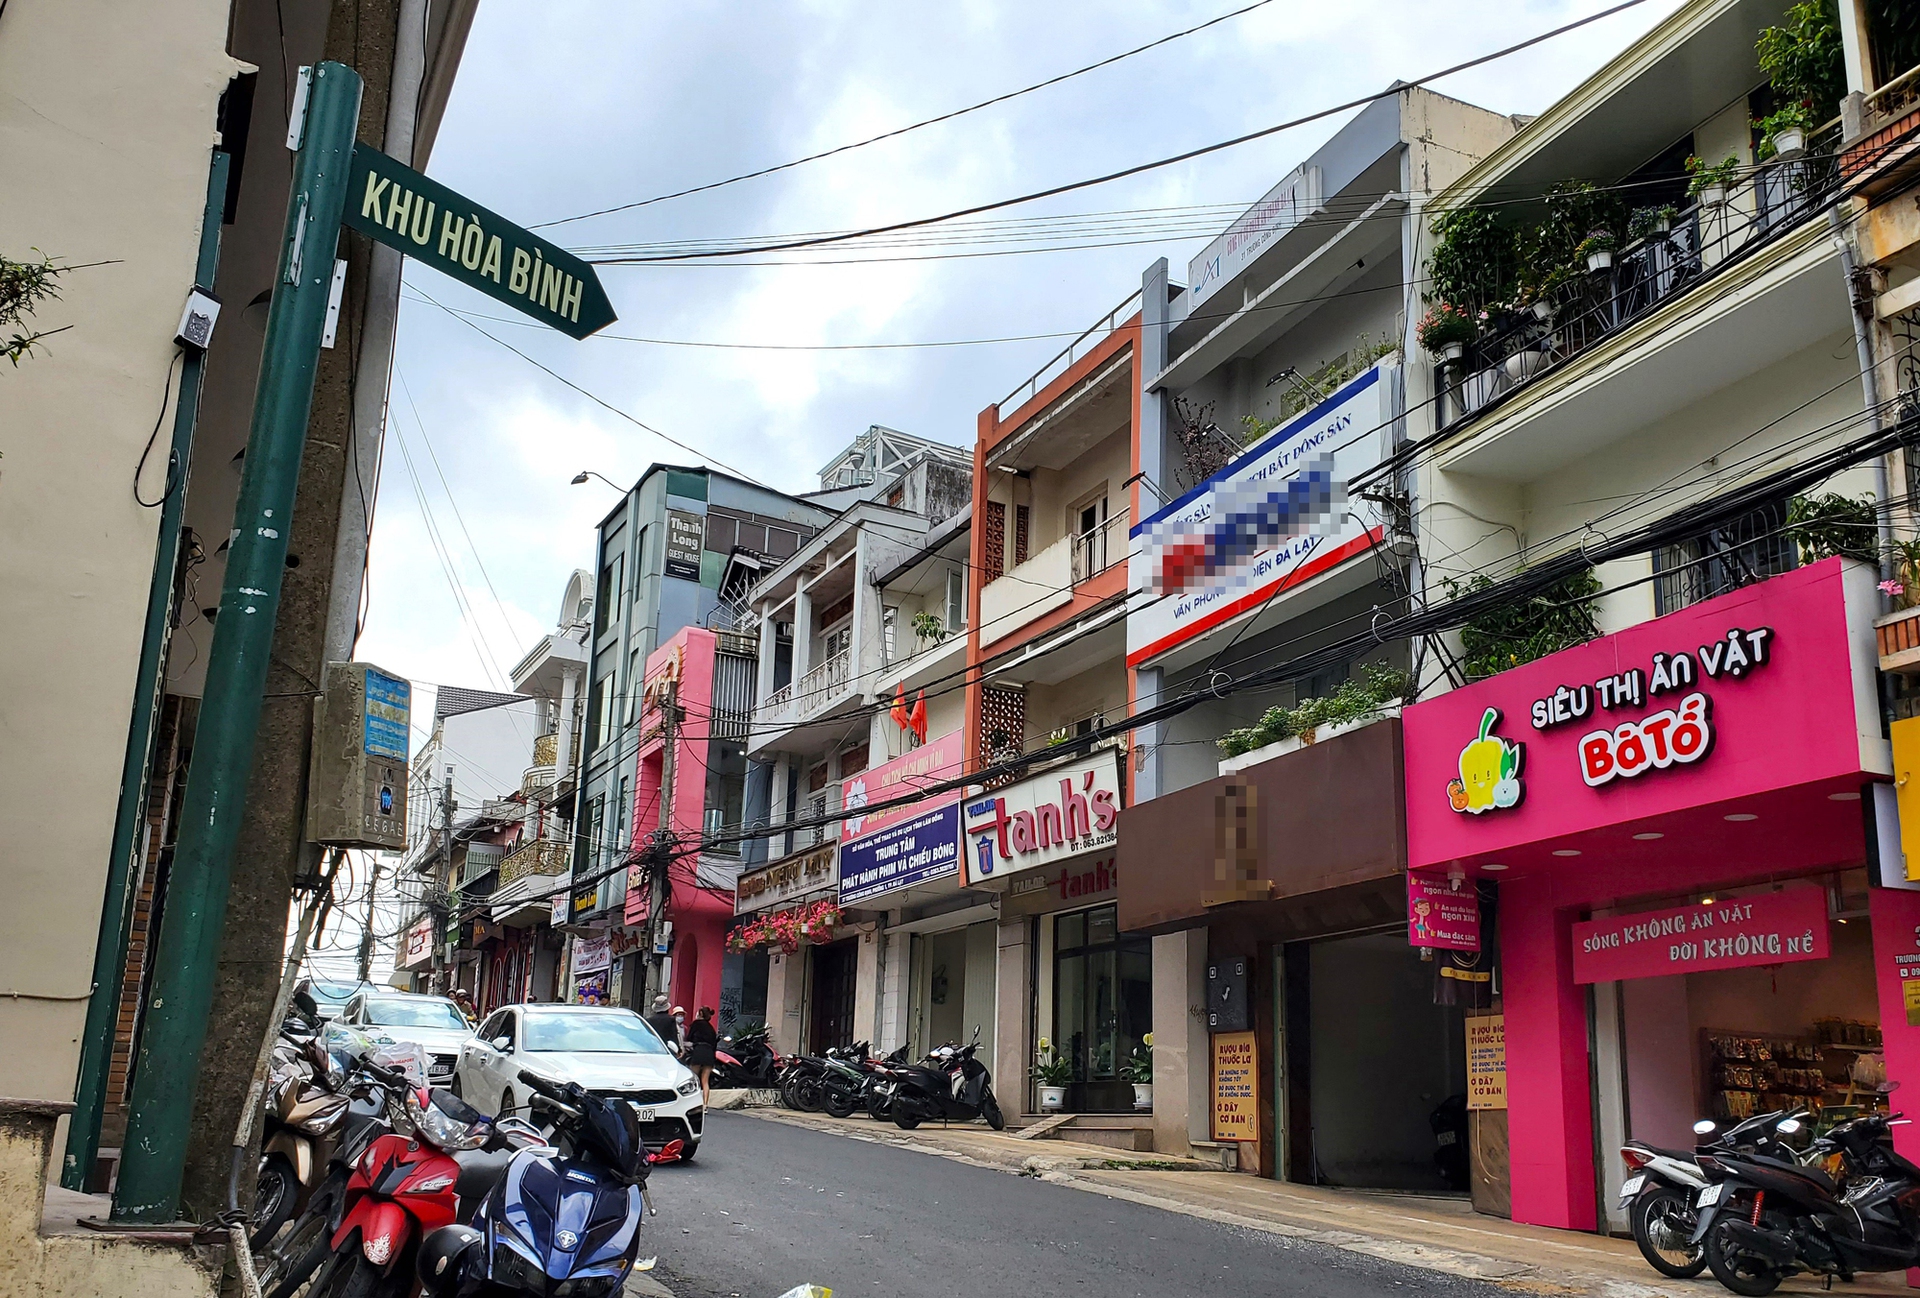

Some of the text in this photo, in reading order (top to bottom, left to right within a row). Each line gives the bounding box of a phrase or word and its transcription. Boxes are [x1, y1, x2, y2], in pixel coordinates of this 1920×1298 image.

[361, 170, 584, 324] KHU HÒA BÌNH
[1268, 451, 1291, 476] BẤT
[1327, 413, 1352, 438] SẢN
[670, 517, 702, 535] Thanh
[672, 532, 699, 551] Long
[668, 548, 700, 564] GUEST HOUSE
[1173, 601, 1191, 620] VĂN
[1532, 685, 1589, 729] SIÊU
[1596, 669, 1641, 708] THỊ
[1699, 629, 1768, 677] VẶT
[968, 798, 995, 818] TAILOR
[875, 836, 916, 861] TRUNG TÂM
[841, 872, 859, 891] PHÁT
[859, 868, 878, 885] HÀNH
[878, 860, 897, 879] PHIM
[897, 855, 908, 872] VÀ
[908, 846, 932, 869] CHIẾU
[932, 842, 955, 861] BÓNG
[1013, 875, 1046, 894] TAILOR
[1441, 911, 1462, 921] ngon
[1624, 914, 1686, 944] KHÔNG
[1691, 912, 1714, 931] ĂN
[1719, 903, 1752, 924] VẶT
[1437, 930, 1451, 939] Mua
[1670, 941, 1698, 961] ĐỜI
[1704, 932, 1781, 959] KHÔNG
[1219, 1053, 1240, 1064] THUỐC
[566, 1171, 597, 1185] HONDA
